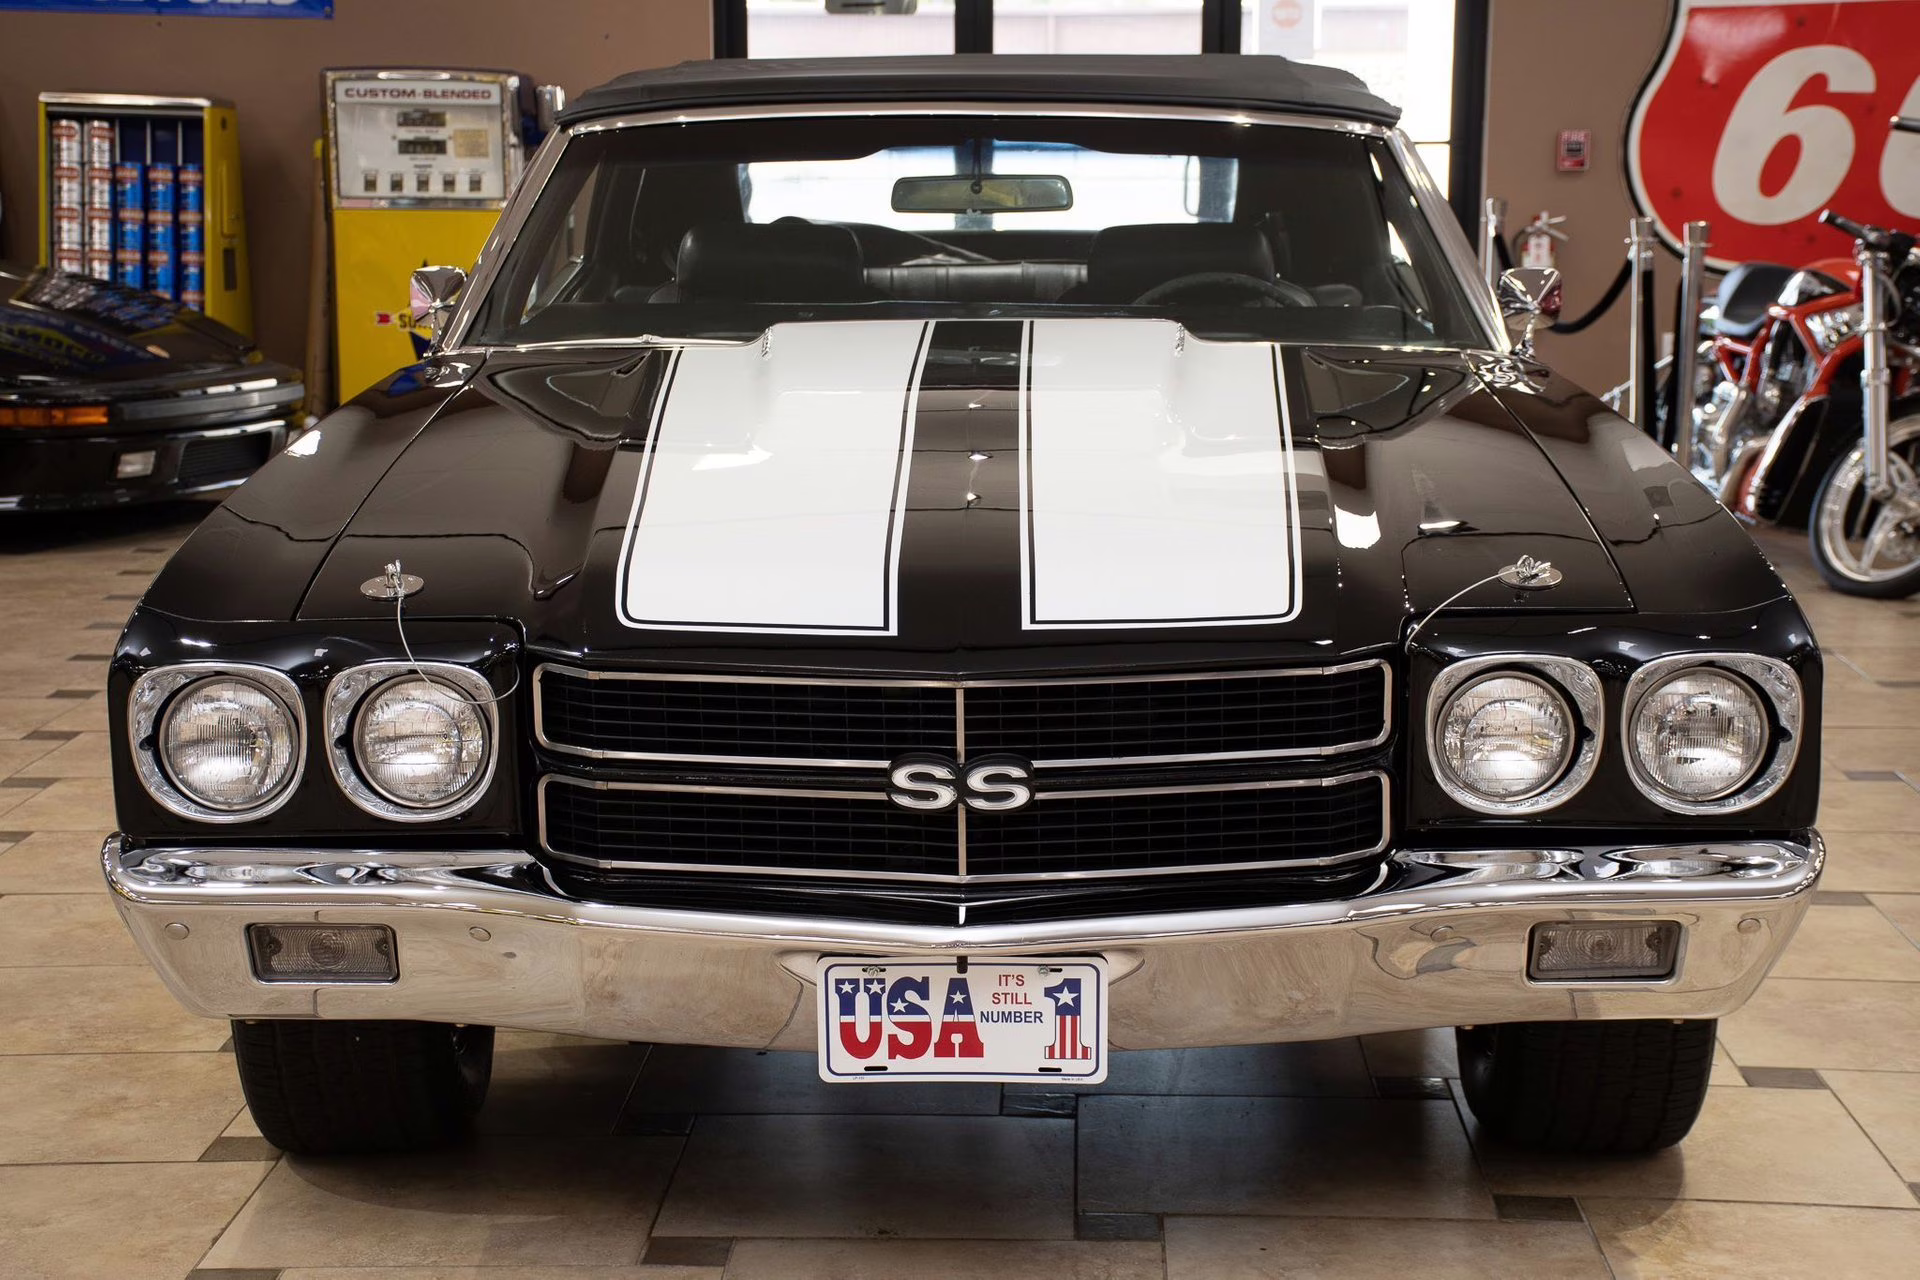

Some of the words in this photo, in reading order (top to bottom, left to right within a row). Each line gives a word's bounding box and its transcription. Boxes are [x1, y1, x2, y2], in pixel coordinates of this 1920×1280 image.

[1711, 43, 1920, 226] 6
[890, 763, 1031, 811] SS
[991, 992, 1033, 1006] STILL
[998, 973, 1025, 987] IT'S
[834, 975, 985, 1060] USA
[979, 1010, 1044, 1024] NUMBER
[1043, 977, 1092, 1060] 1
